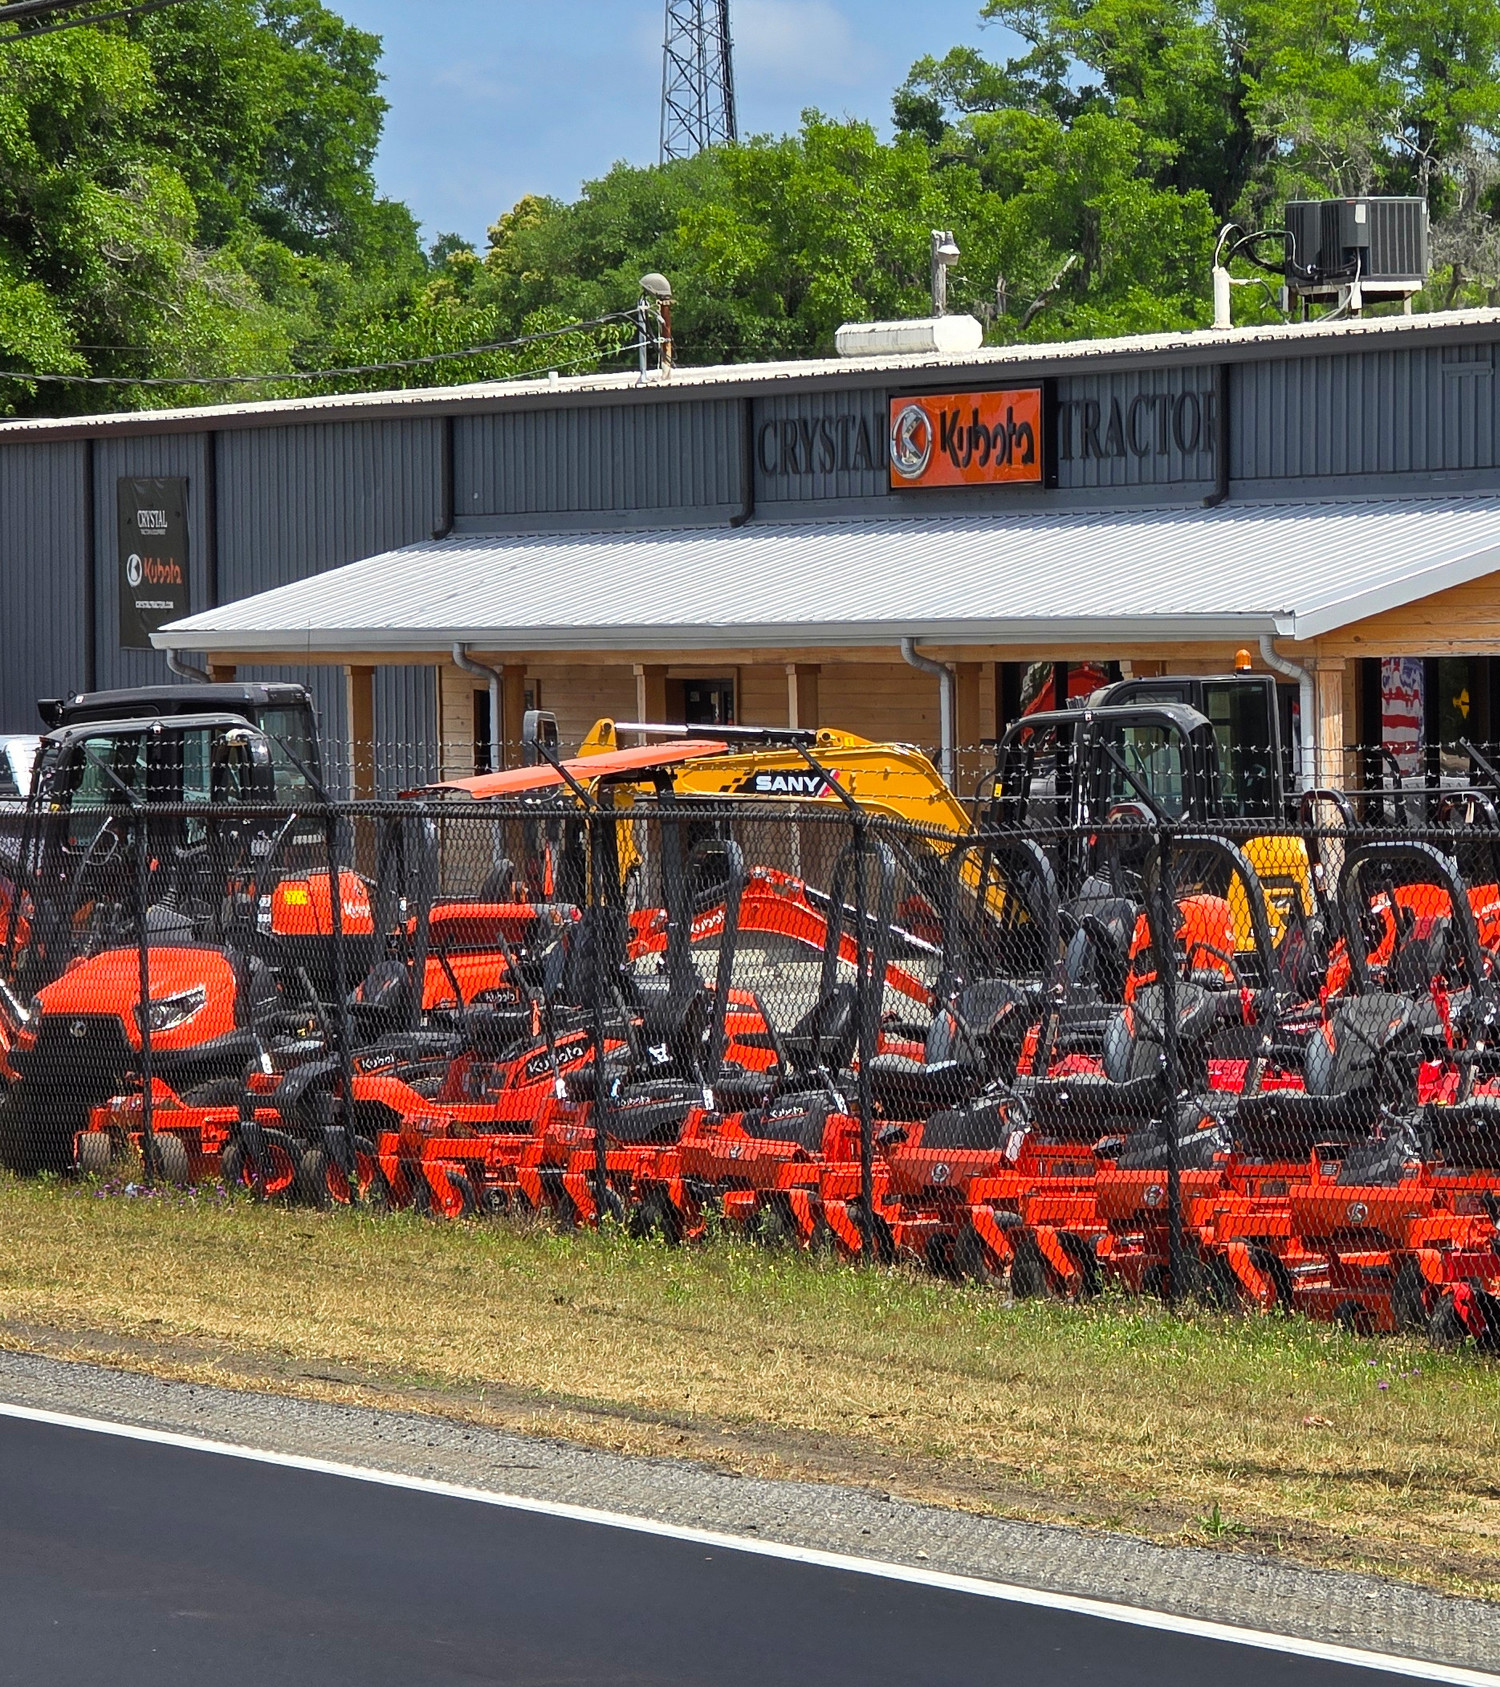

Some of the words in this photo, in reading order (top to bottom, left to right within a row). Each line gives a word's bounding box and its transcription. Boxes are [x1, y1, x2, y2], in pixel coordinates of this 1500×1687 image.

[940, 406, 1034, 469] Kubota
[137, 510, 168, 528] CRYSTAL
[144, 557, 183, 585] Kubota
[755, 775, 821, 793] SANY
[527, 1046, 584, 1073] Kuota
